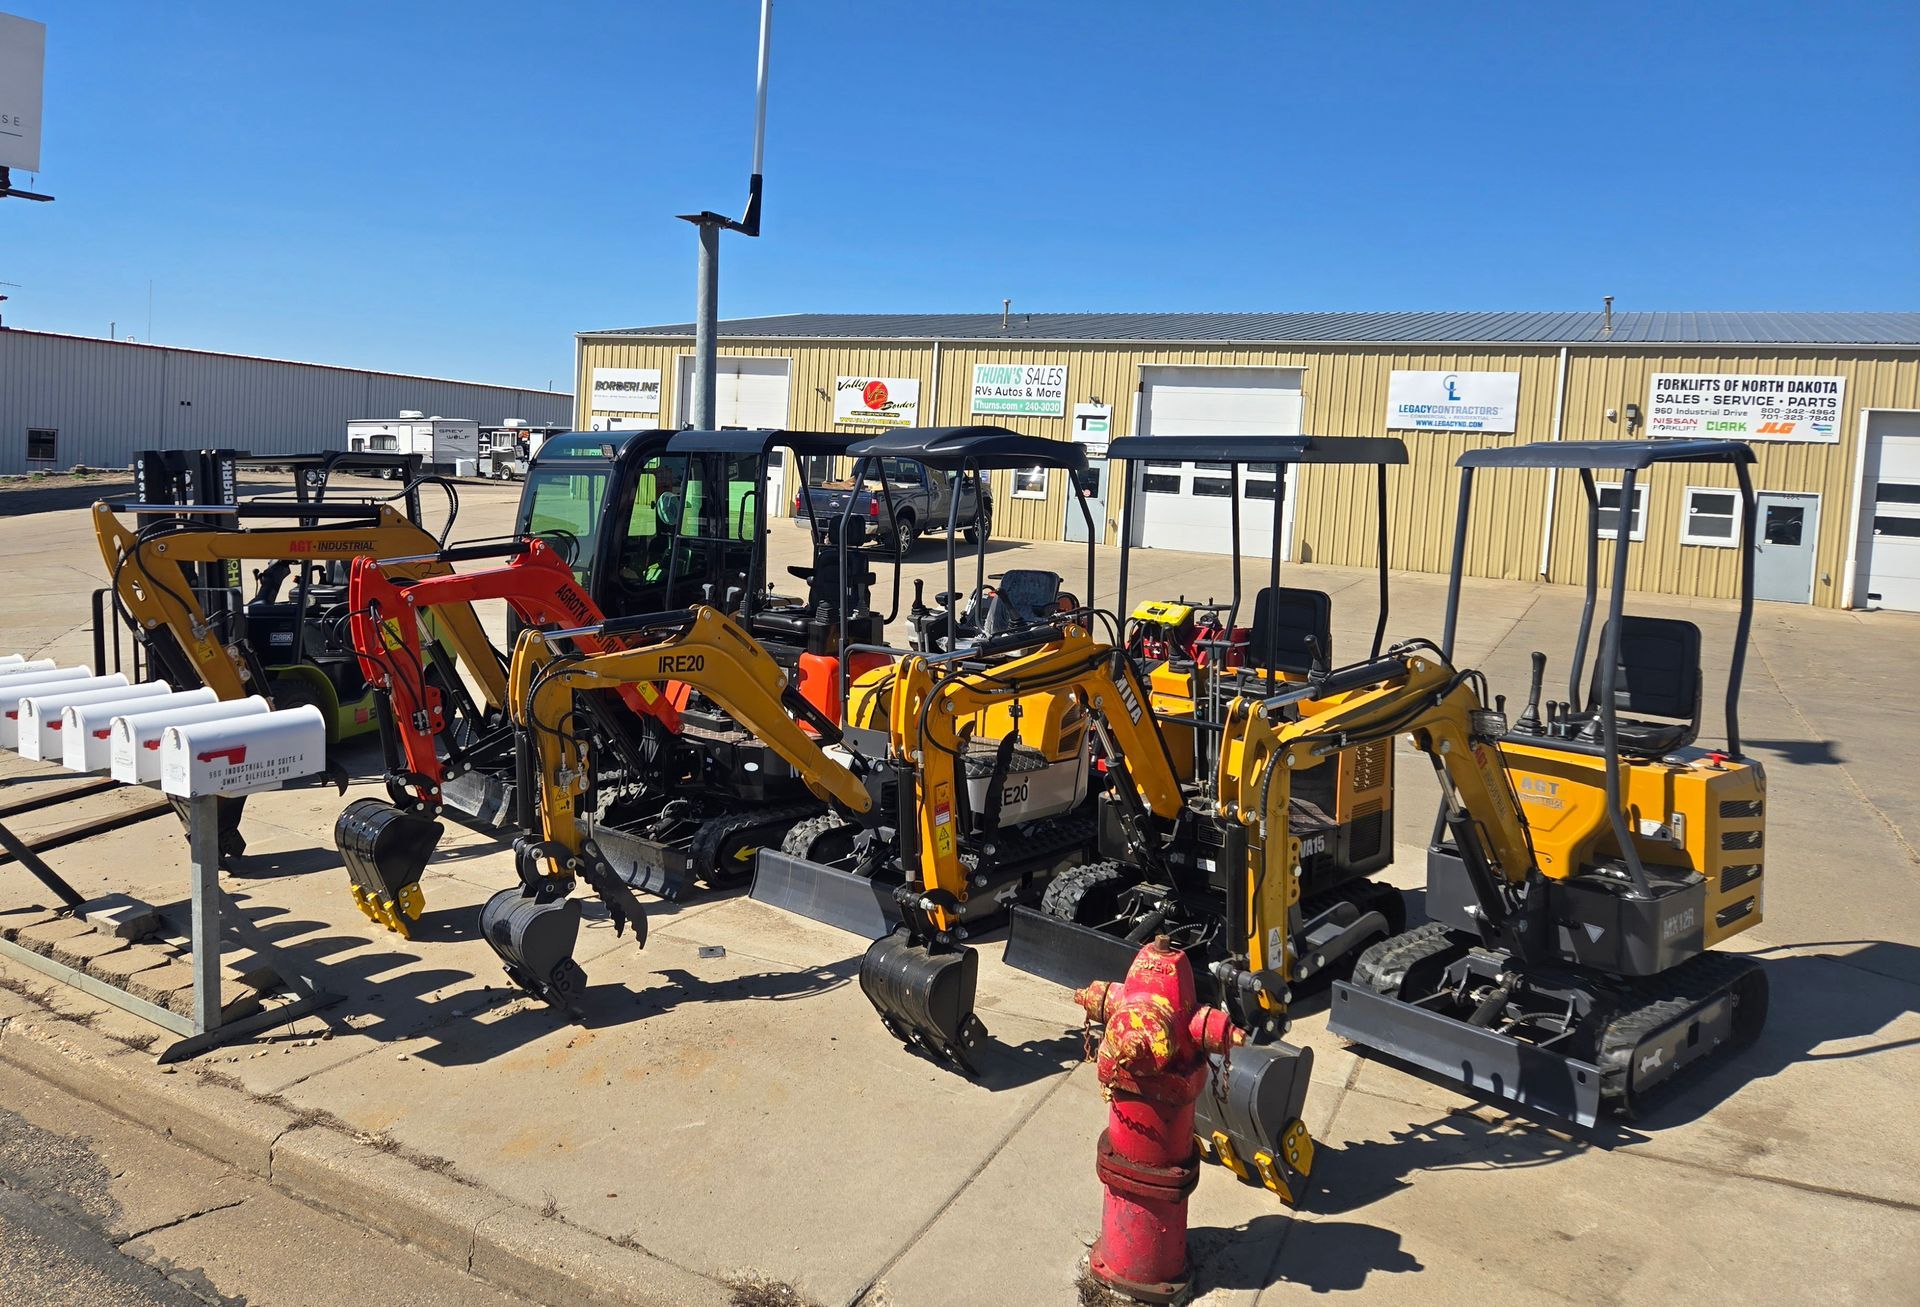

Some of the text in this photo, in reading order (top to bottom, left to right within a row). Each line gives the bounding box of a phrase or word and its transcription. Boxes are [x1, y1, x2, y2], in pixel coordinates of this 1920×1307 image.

[976, 367, 1063, 386] THURN'S SALES
[975, 386, 1061, 398] RVs Autos & More
[1657, 379, 1837, 394] FORKLIFTS OF NORTH DAKOTA
[975, 400, 1060, 412] Thurns.com 240-3030
[1656, 394, 1837, 407] SALES SERVICE PARTS
[1676, 408, 1720, 416] Industrial
[1706, 421, 1796, 434] CLARK JLG
[222, 460, 234, 505] CLARK
[318, 540, 375, 551] INDUSTRIAL
[658, 654, 705, 673] IRE20
[225, 761, 264, 775] INDUSTRIAL
[1002, 784, 1028, 807] E20
